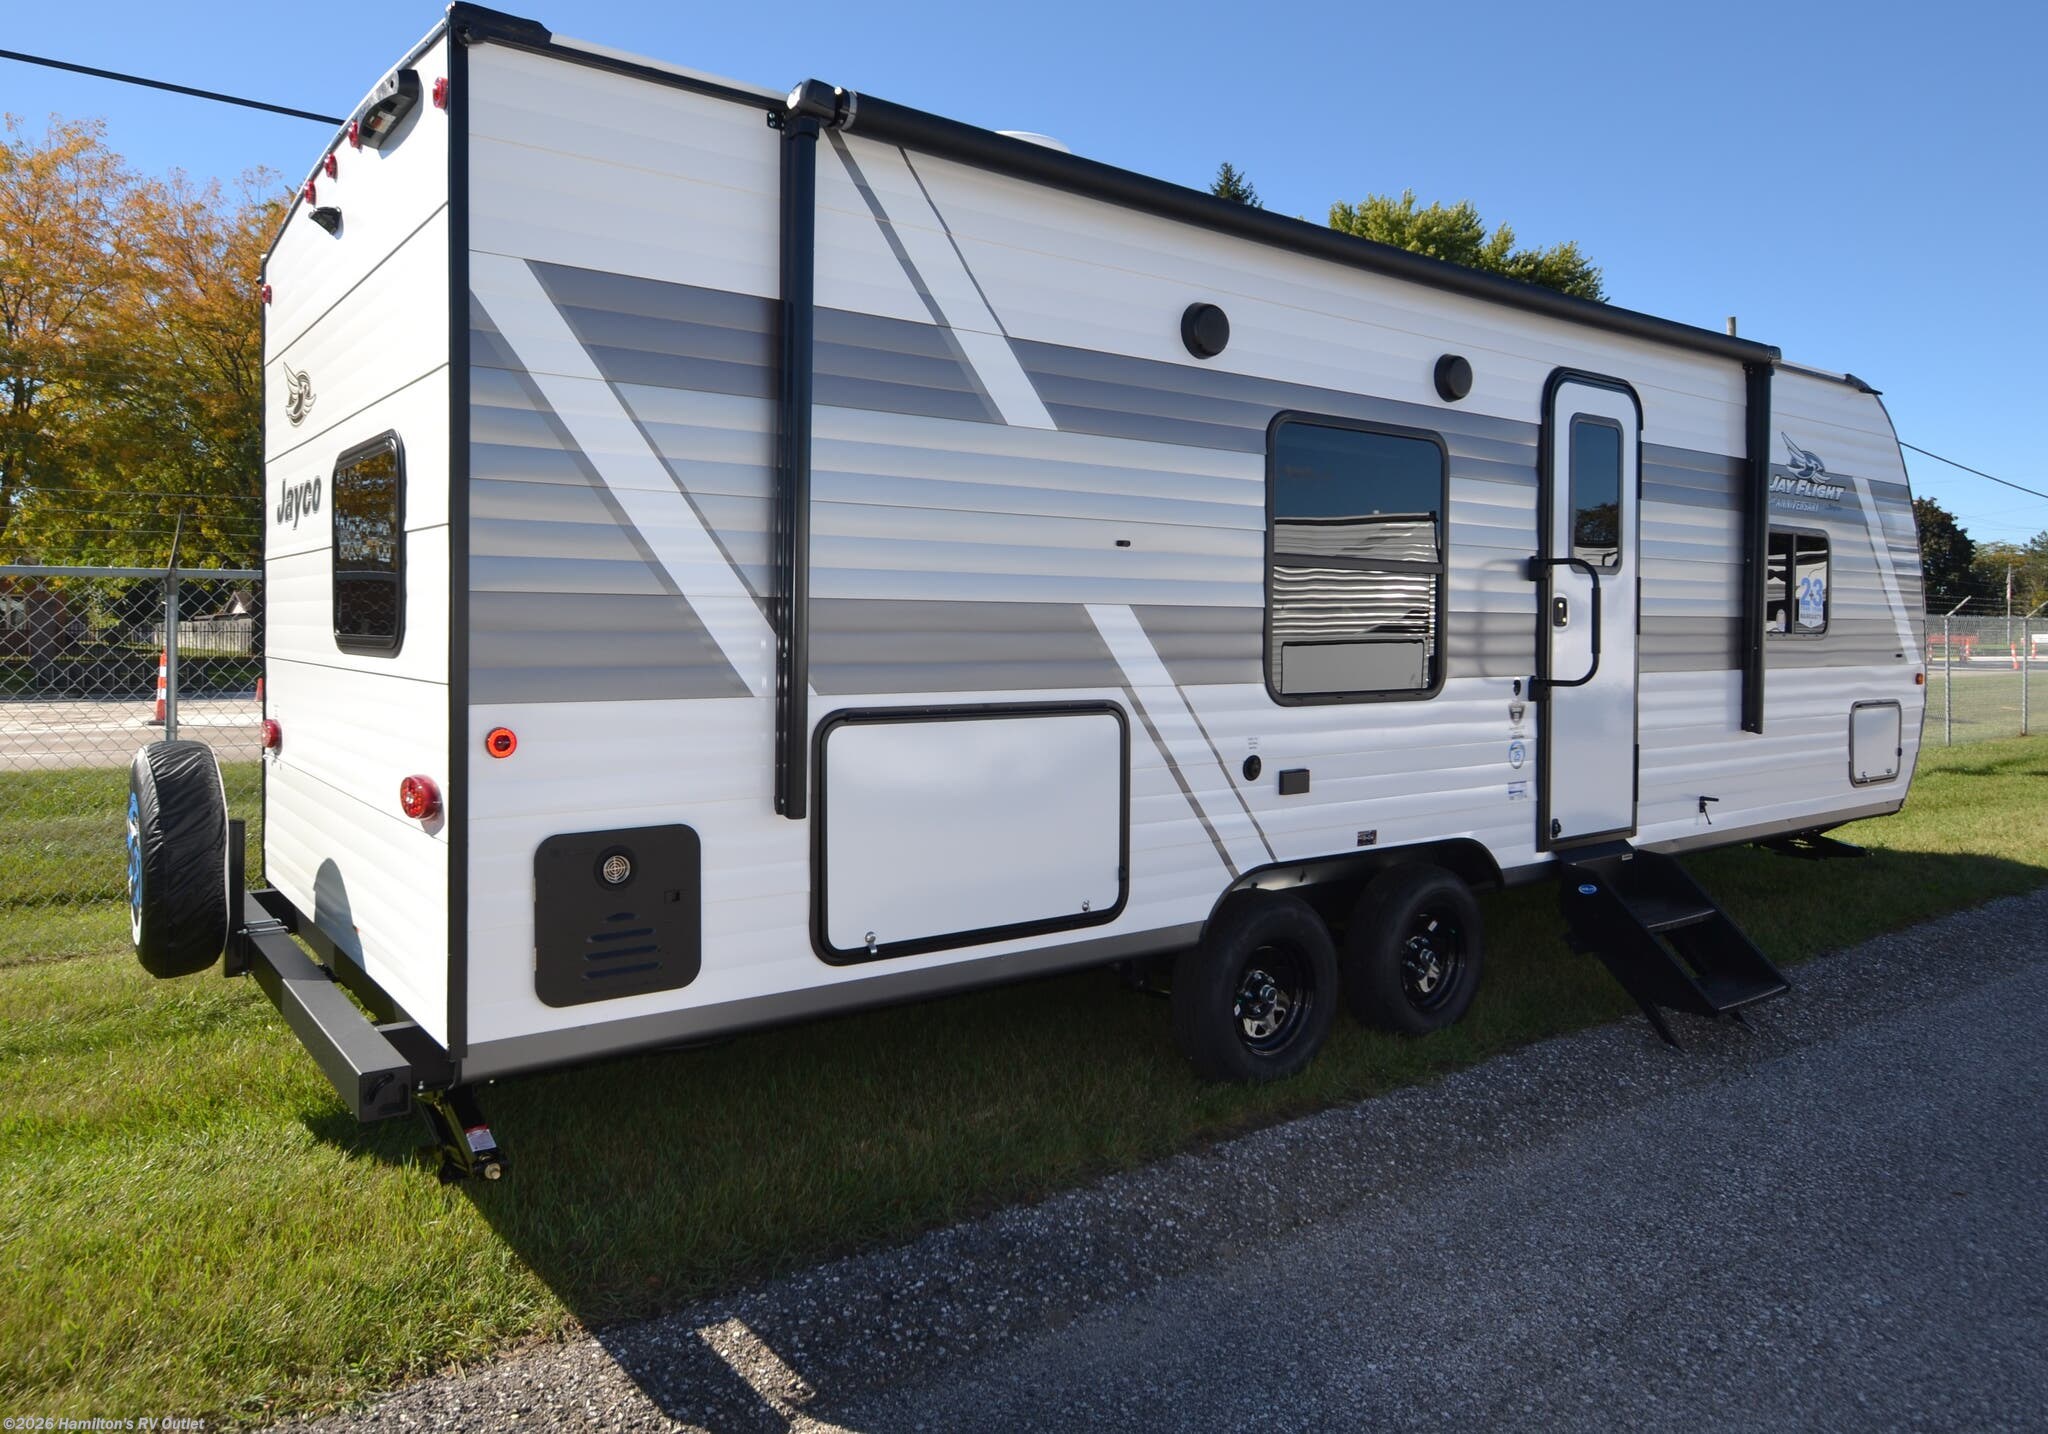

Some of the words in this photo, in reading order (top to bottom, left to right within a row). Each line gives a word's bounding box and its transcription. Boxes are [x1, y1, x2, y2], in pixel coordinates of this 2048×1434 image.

[277, 476, 322, 530] Jayco
[1769, 475, 1796, 494] JAY
[1795, 479, 1845, 500] FLIGHT
